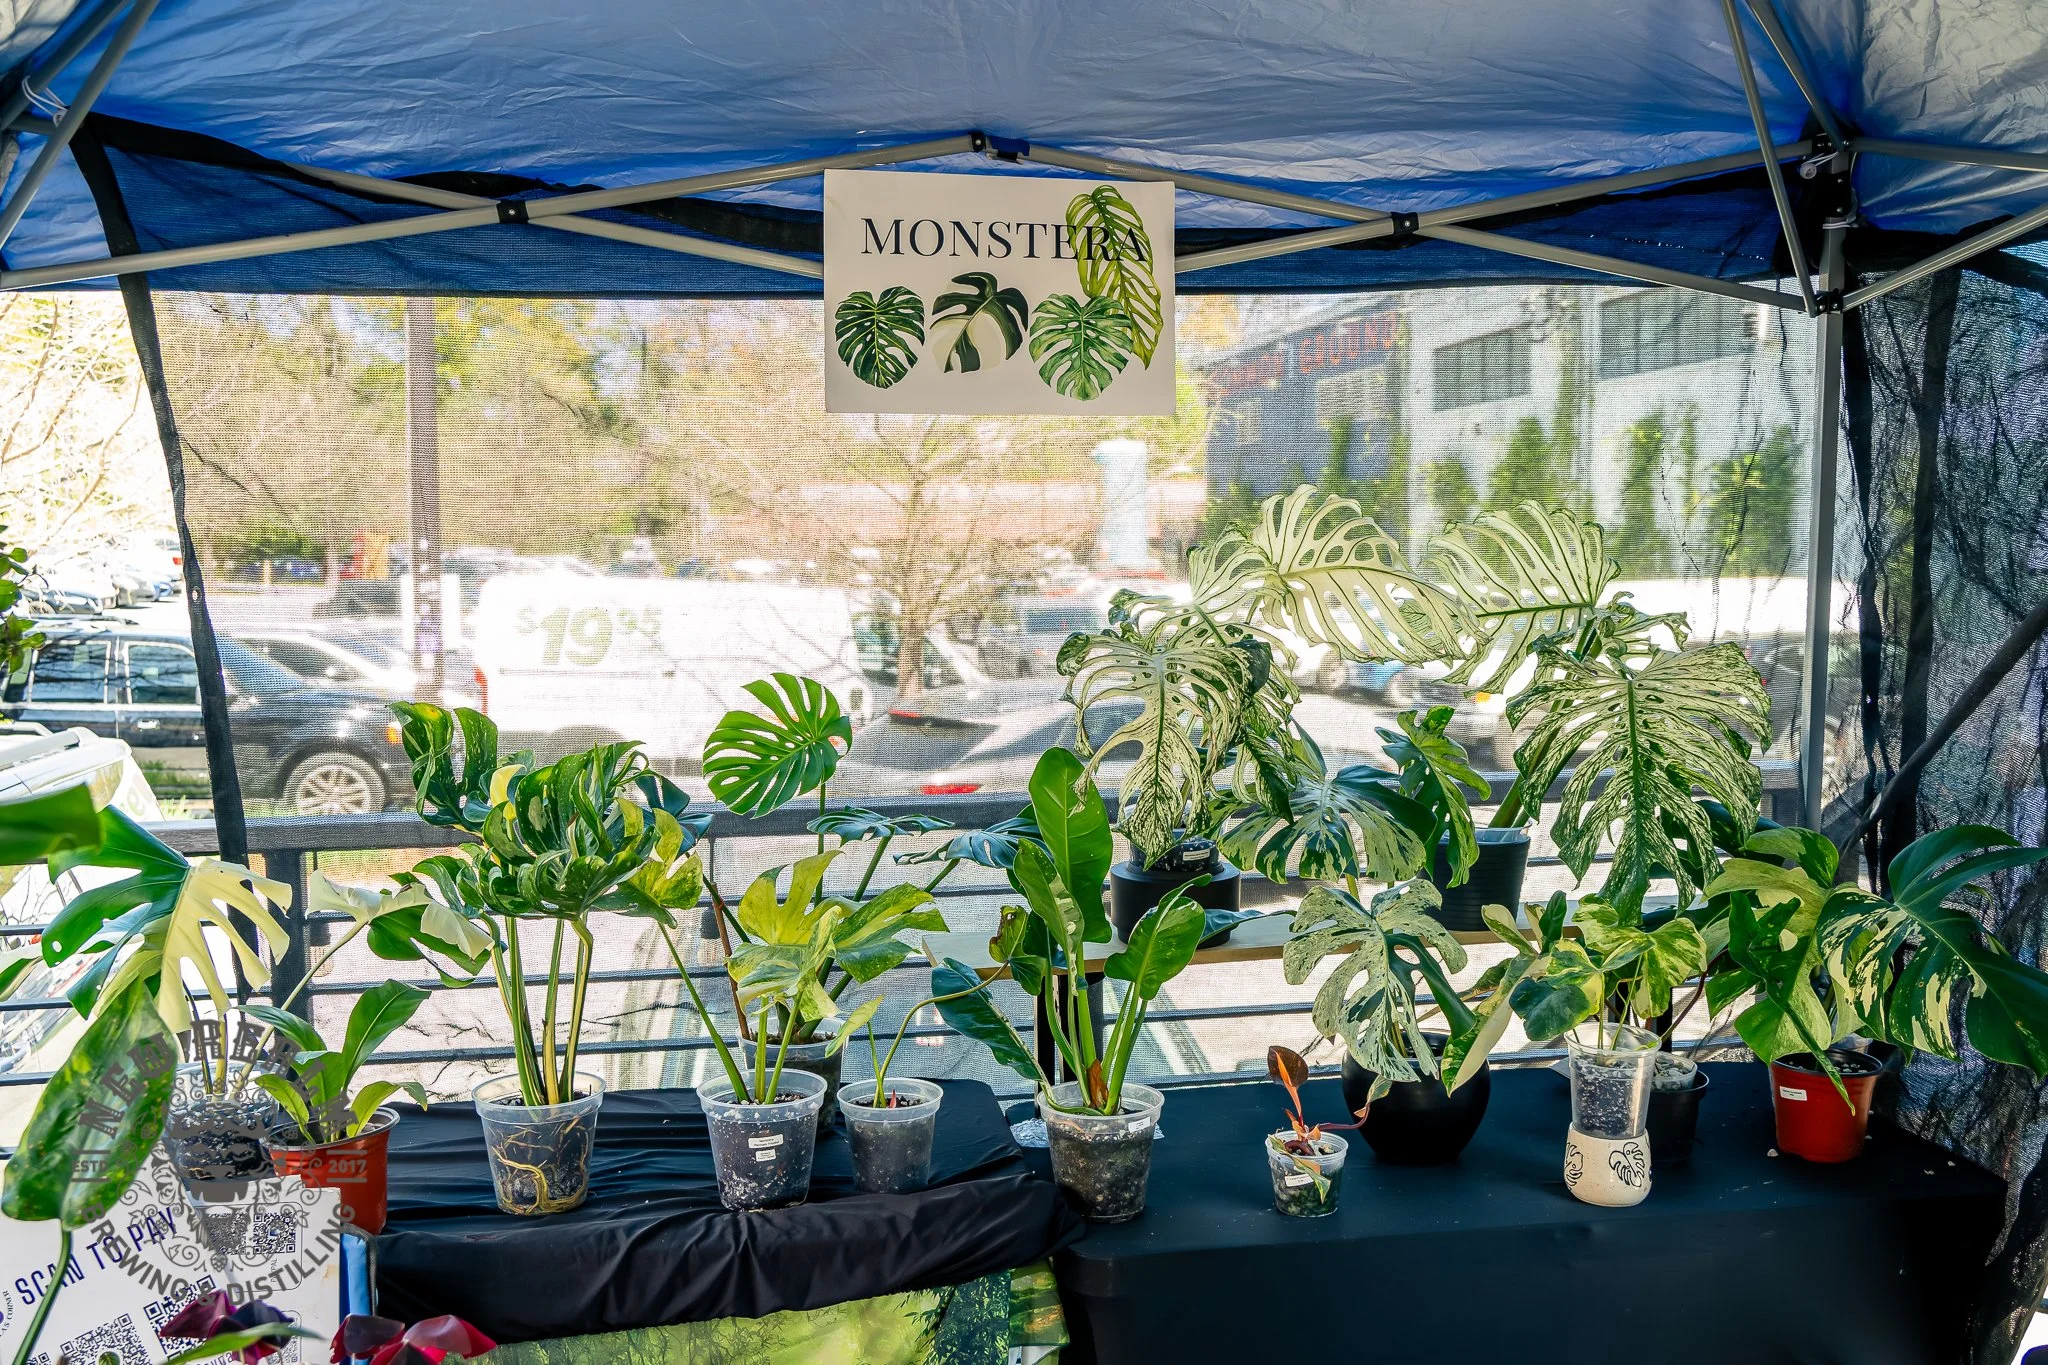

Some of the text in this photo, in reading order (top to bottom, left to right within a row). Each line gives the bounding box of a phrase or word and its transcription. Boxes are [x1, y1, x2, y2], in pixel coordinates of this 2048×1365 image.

[861, 217, 1148, 262] MONSTERA
[86, 1235, 123, 1270] TO
[127, 1206, 177, 1253] PAY
